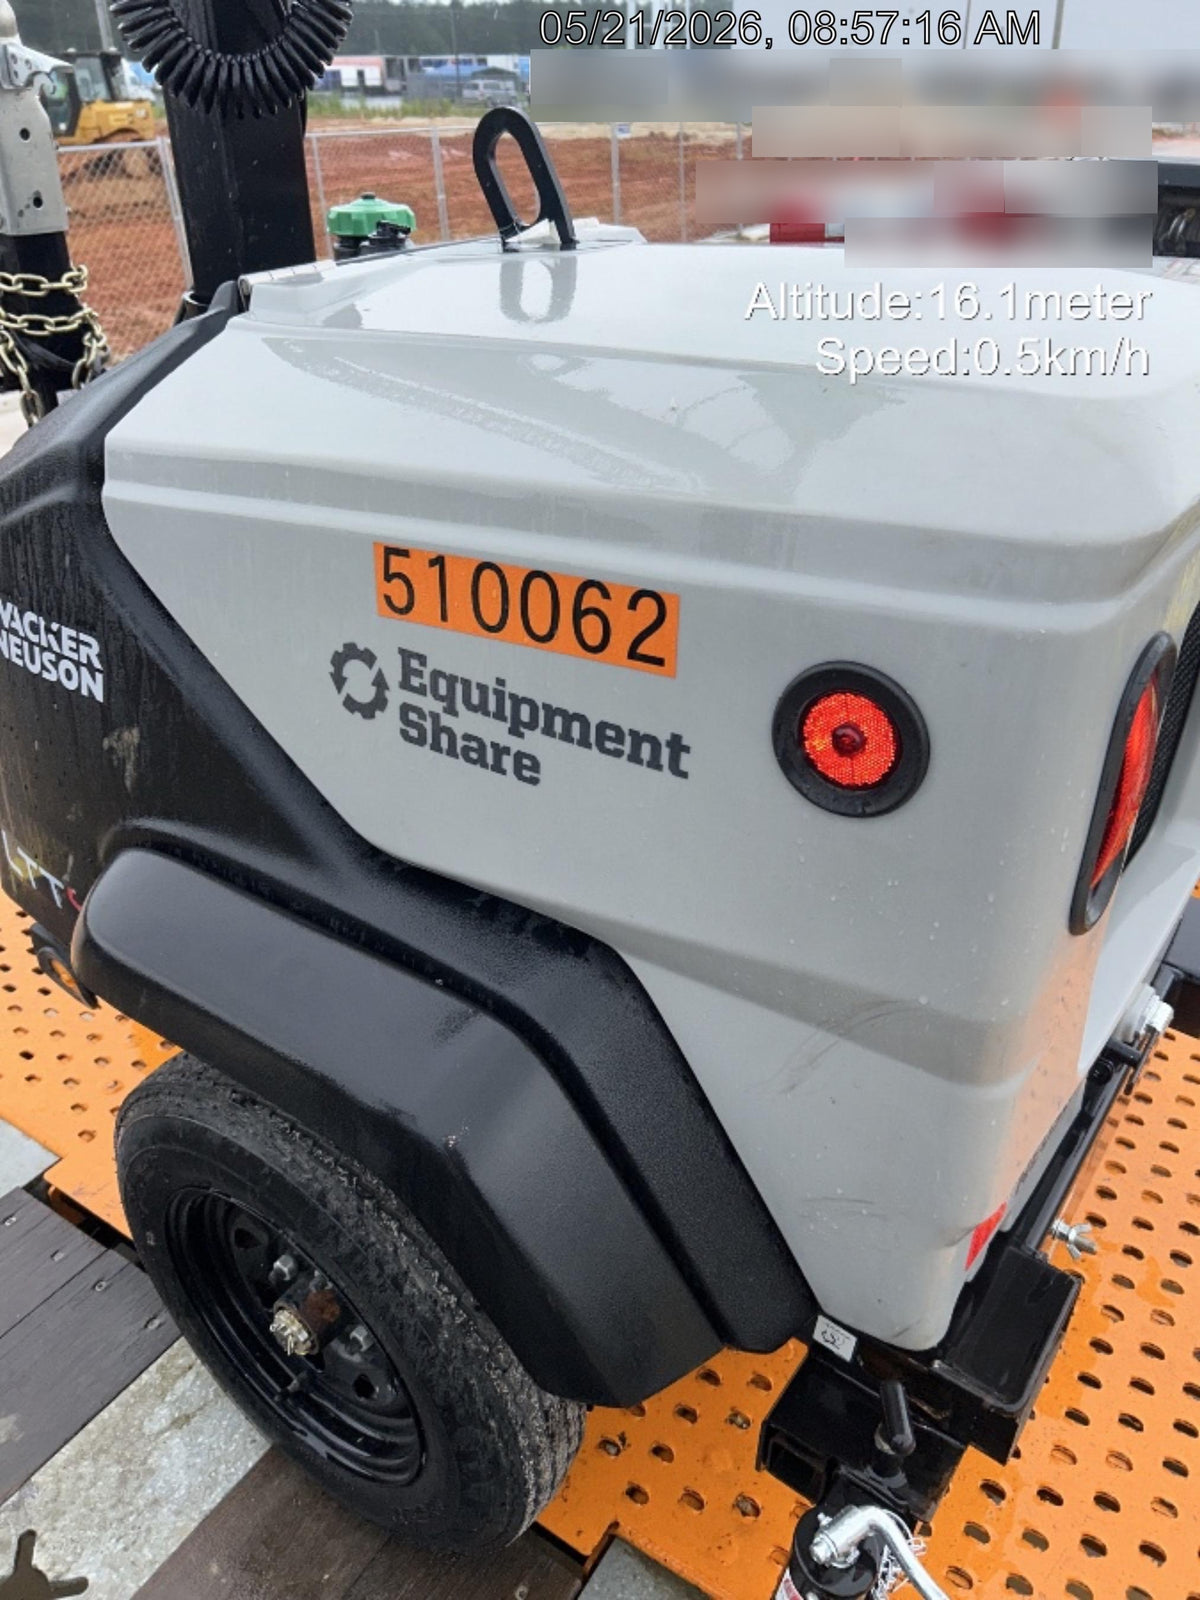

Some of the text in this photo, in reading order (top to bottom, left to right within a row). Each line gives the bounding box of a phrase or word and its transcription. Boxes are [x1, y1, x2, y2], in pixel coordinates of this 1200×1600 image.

[383, 545, 668, 667] 510062
[397, 646, 691, 779] Equipment
[399, 702, 541, 786] Share
